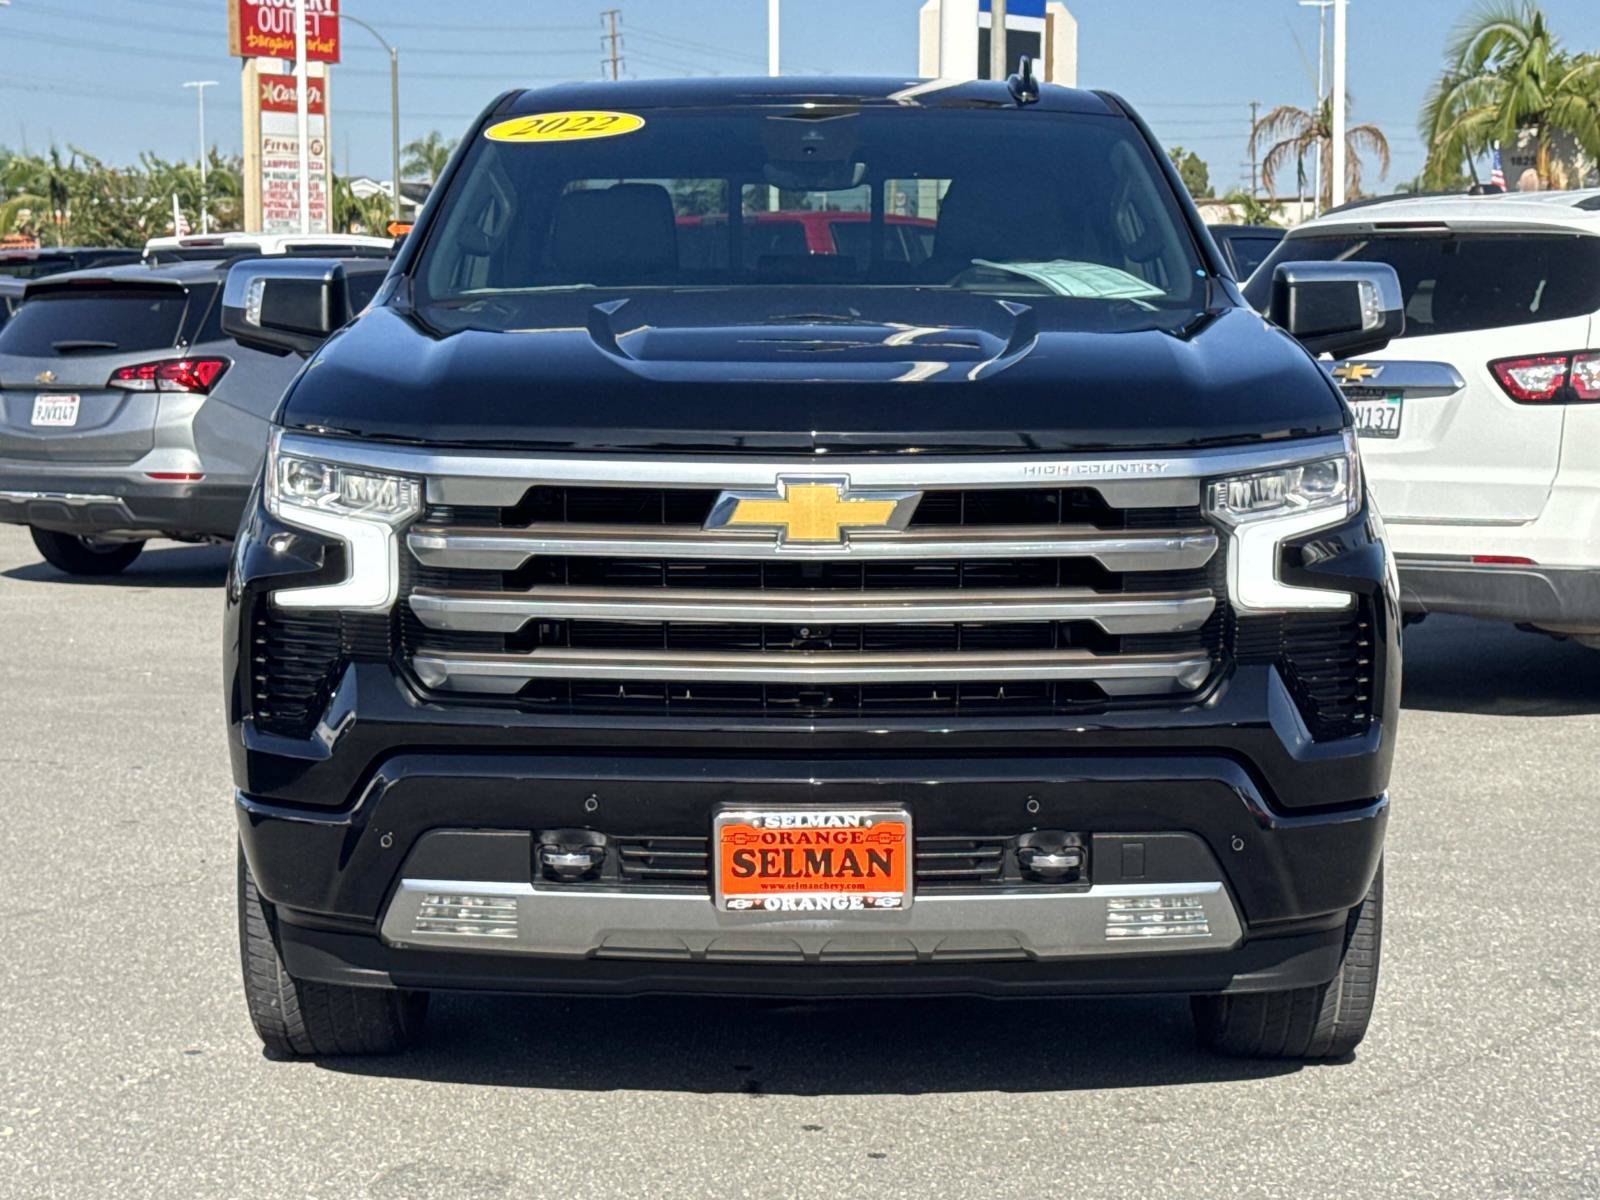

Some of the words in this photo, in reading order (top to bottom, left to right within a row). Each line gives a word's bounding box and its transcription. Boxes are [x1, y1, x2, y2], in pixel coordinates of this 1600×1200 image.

[508, 116, 620, 137] 2022
[307, 161, 324, 170] IZZA
[1024, 464, 1070, 475] HIGH
[1077, 463, 1169, 474] COUNTRY
[764, 815, 861, 828] SELMAN
[761, 831, 865, 845] ORANGE
[731, 848, 895, 878] SELMAN
[760, 881, 866, 891] www.selmanchevy.com
[763, 896, 865, 911] ORANGE
